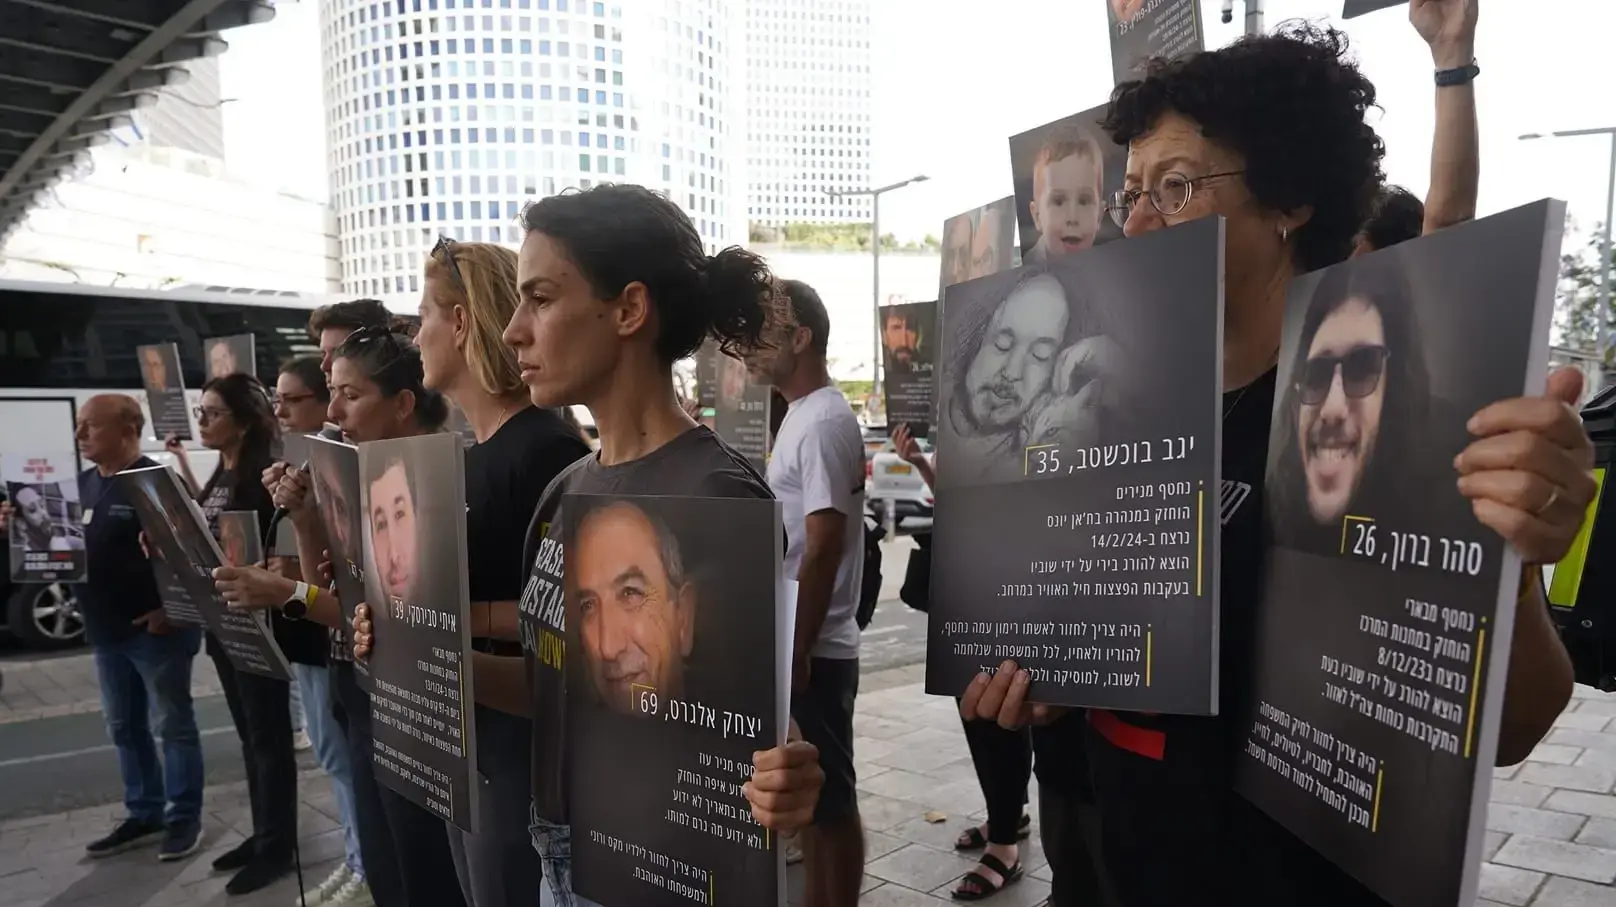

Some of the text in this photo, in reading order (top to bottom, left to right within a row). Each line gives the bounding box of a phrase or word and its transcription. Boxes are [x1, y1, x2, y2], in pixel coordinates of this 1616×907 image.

[1036, 436, 1194, 475] יגב בוכשטב, 35
[1116, 481, 1191, 500] נחטף מנירים
[1047, 514, 1067, 528] יונס
[1105, 508, 1150, 525] במנהרה
[1154, 505, 1190, 525] הוחזק
[1160, 530, 1190, 545] נרצח
[1353, 523, 1483, 576] סהר ברוך, 26
[1030, 554, 1190, 573] הוצא להורג בירי על ידי שוביו
[996, 581, 1190, 599] בעקבות הפצצות חיל האוויר במרחב.
[395, 600, 404, 620] 39
[1404, 598, 1438, 623] מבארי
[440, 611, 456, 632] איתי
[941, 621, 1141, 640] היה צריך לחזור לאשתו רימון עמה נחטף,
[1359, 614, 1471, 663] הוחזק במחנות המרכז
[953, 642, 1141, 662] להוריו ולאחיו, לכל המשפחה שנלחמה
[1023, 667, 1049, 682] ולכל
[1053, 670, 1099, 686] למוסיקה
[1103, 672, 1141, 688] לשובו,
[1435, 666, 1467, 693] נרצח
[1320, 655, 1463, 724] הוצא להורג על ידי שוביו בעת
[1321, 682, 1348, 705] לאזור.
[640, 691, 762, 739] יצחק אלגרט, 69
[1375, 703, 1404, 730] כוחות
[1260, 700, 1376, 774] היה צריך לחזור לחיק המשפחה
[1406, 716, 1459, 755] התקרבות
[699, 752, 755, 778] חטף מניר עוז
[677, 768, 744, 798] דוע איפה הוחזק
[672, 789, 689, 803] ידוע
[692, 793, 702, 809] לא
[705, 798, 736, 819] בתאריך
[664, 808, 762, 850] ולא ידוע מה גרם למותו.
[590, 829, 707, 882] היה צריך לחזור לילדיו מקס ורוני
[633, 866, 708, 905] ולמשפחתו האוהבת.
